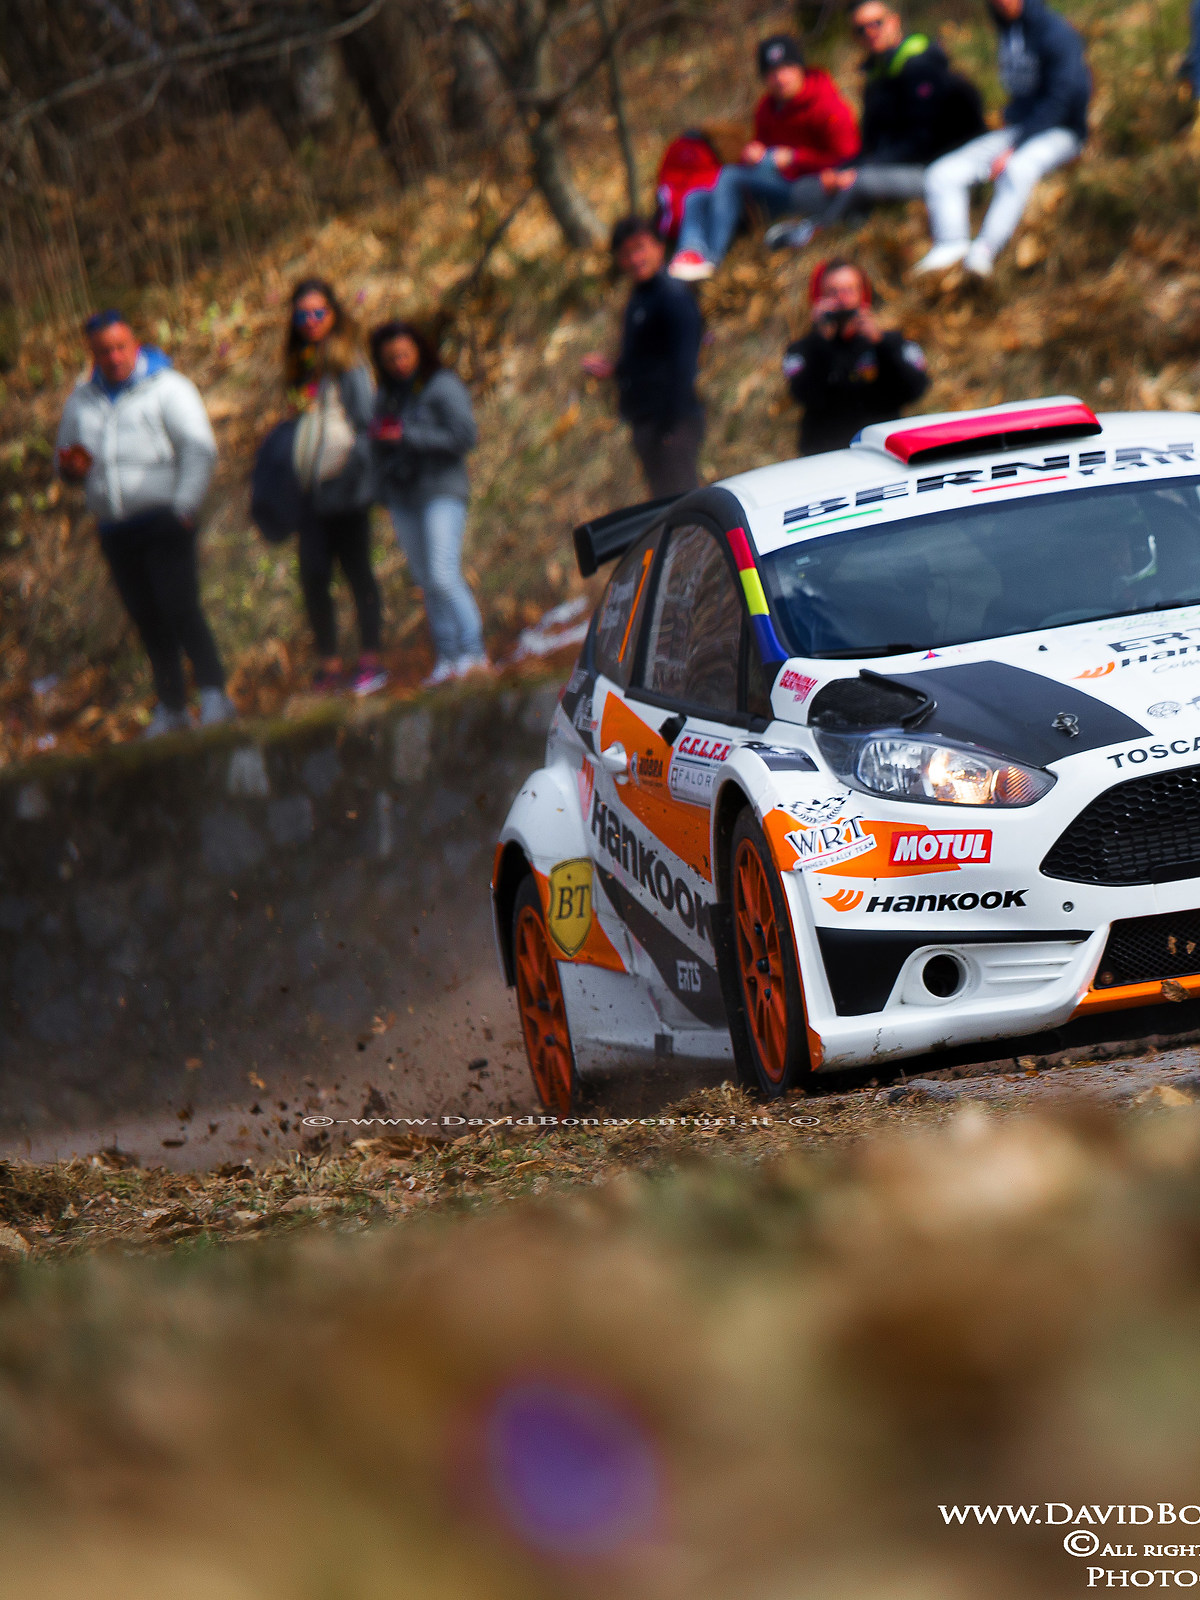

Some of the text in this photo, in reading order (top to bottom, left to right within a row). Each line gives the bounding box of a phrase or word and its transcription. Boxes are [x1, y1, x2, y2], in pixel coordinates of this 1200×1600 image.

[677, 769, 718, 789] FALOR
[788, 816, 864, 857] WRT
[893, 833, 987, 862] MOTUL
[555, 884, 590, 921] BT
